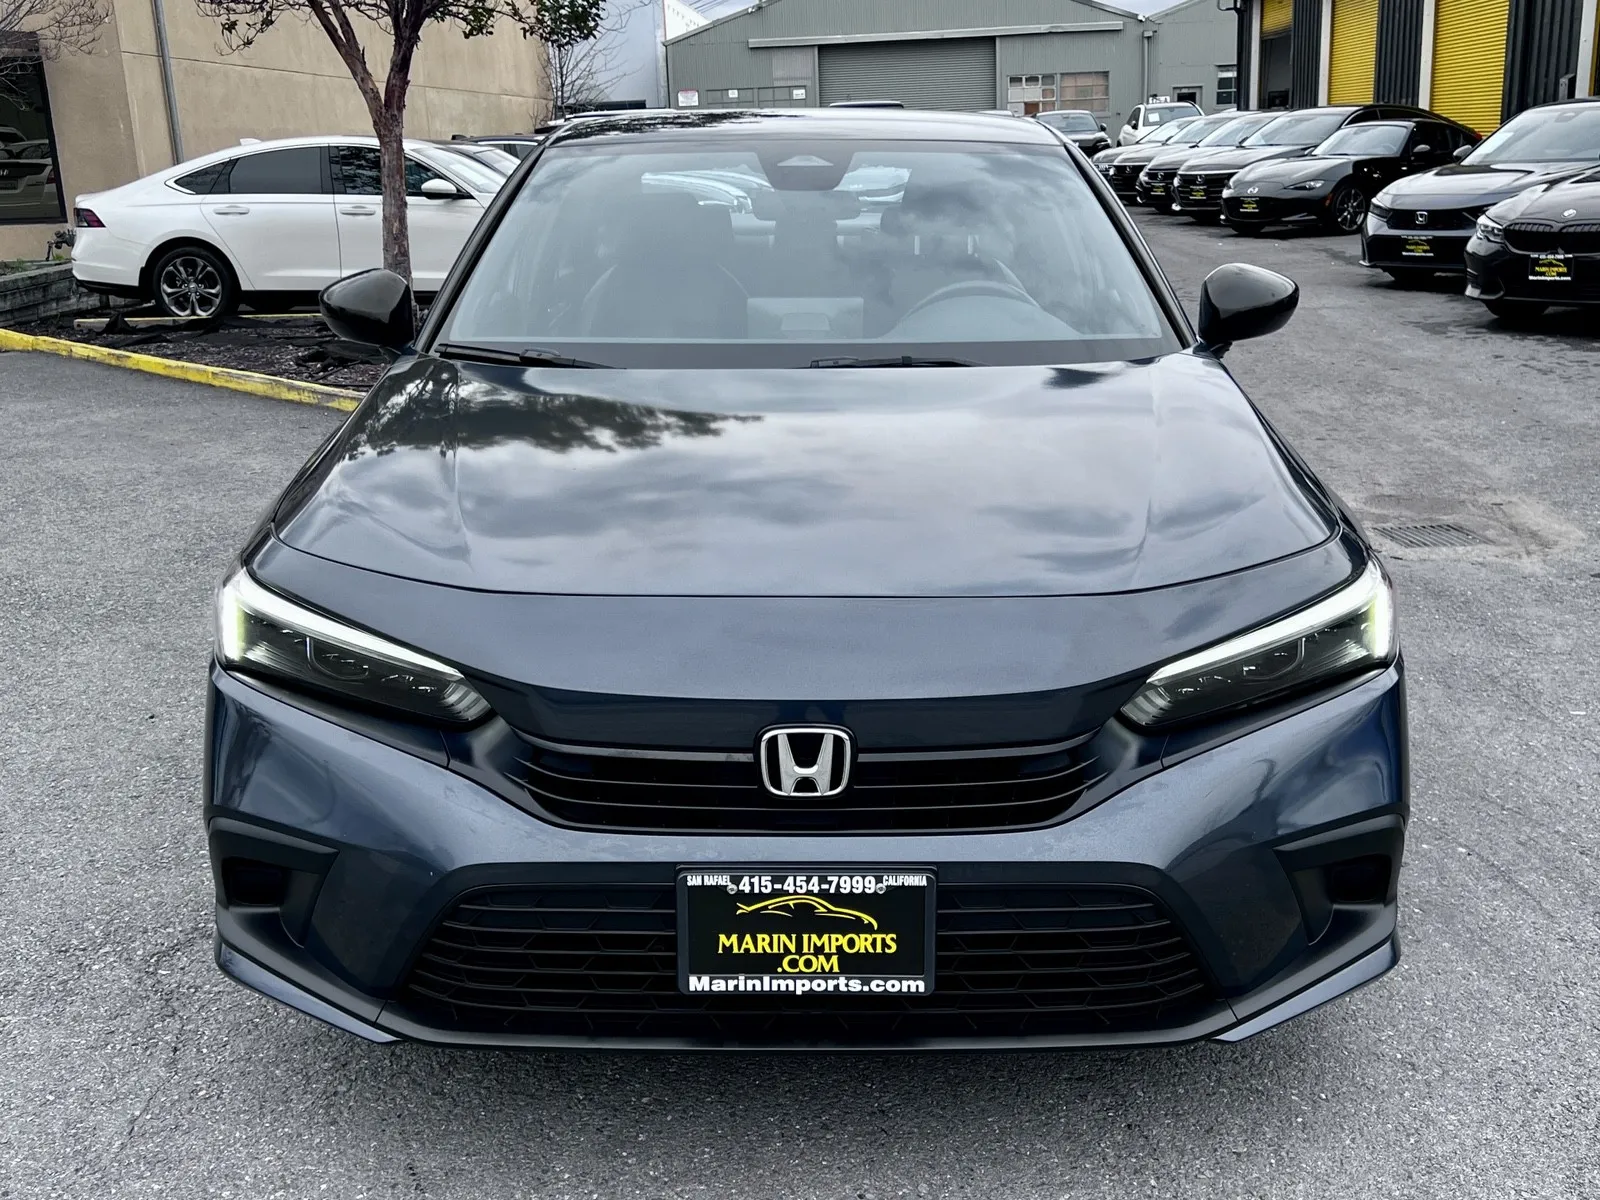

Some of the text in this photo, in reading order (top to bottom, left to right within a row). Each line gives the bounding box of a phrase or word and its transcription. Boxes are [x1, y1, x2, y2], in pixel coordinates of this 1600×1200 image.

[686, 875, 928, 894] SAN RAFAEL 415-454-7999 CALIFORNIA
[717, 933, 898, 954] MARIN IMPORTS
[776, 954, 840, 973] .COM
[688, 976, 926, 995] MarinImports.com
